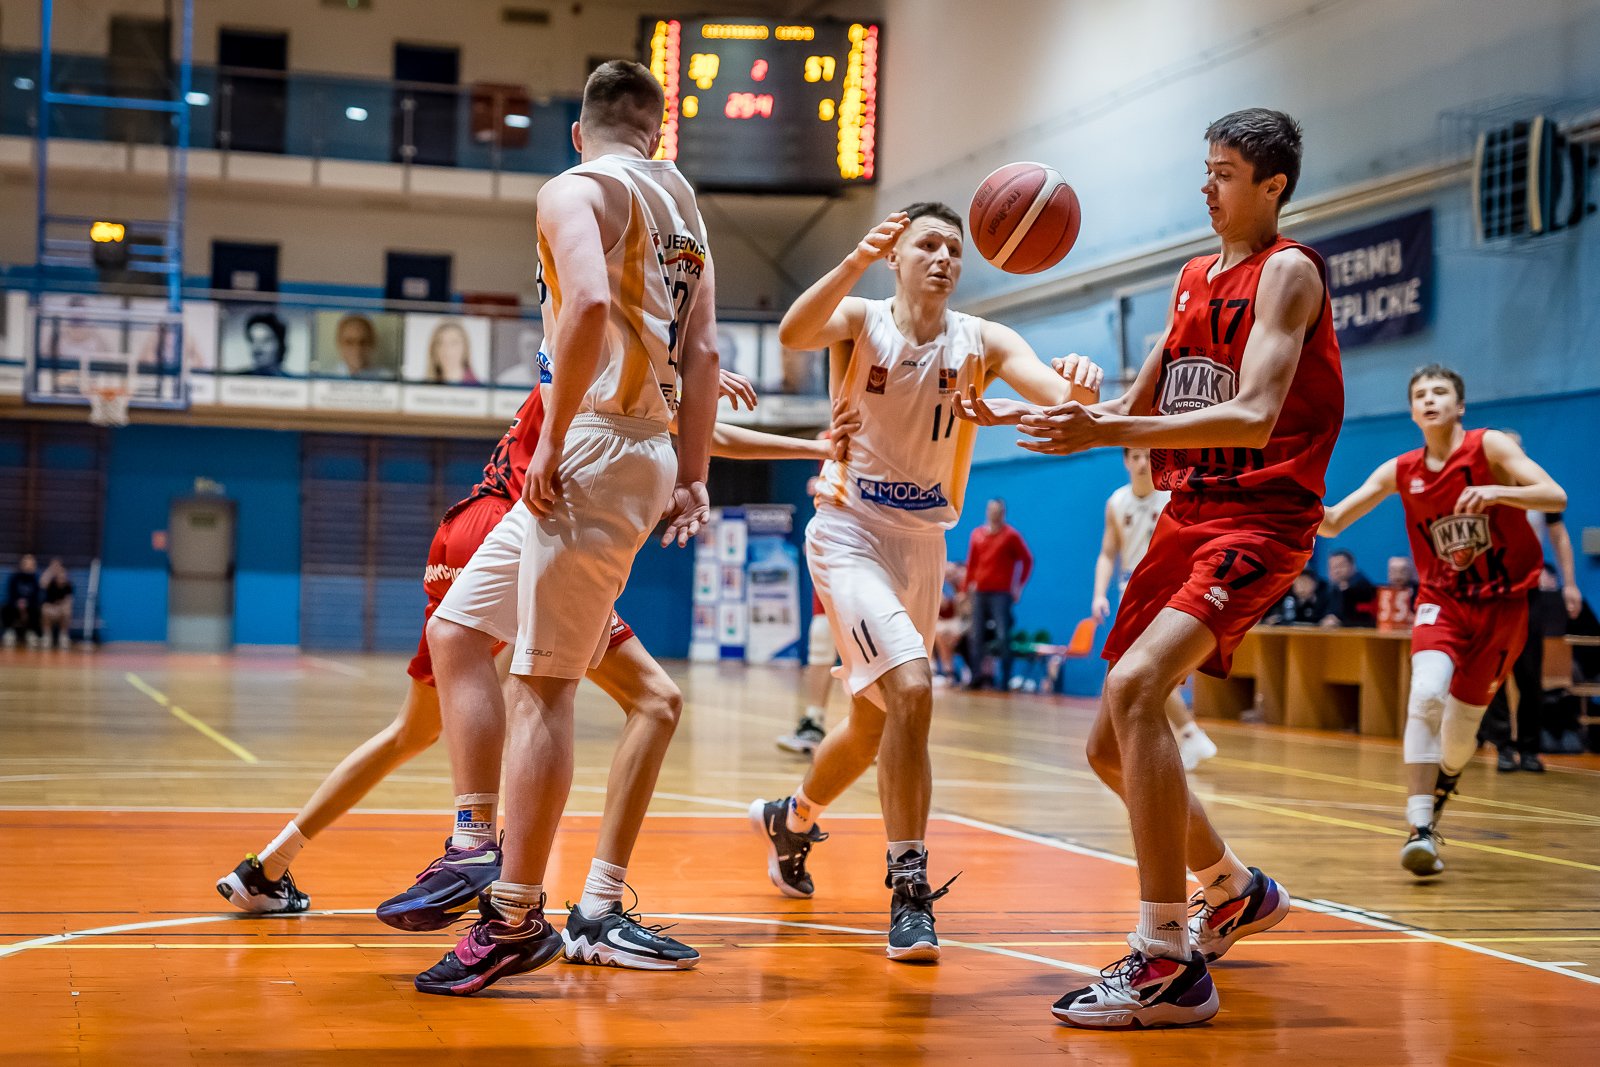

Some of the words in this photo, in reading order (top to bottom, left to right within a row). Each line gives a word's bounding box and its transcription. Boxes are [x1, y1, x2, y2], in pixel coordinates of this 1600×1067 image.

[987, 189, 1022, 236] molten
[1327, 238, 1402, 289] TERMY
[1209, 298, 1250, 345] 17
[1174, 366, 1223, 403] WKK
[1440, 520, 1481, 546] WKK
[1213, 548, 1268, 591] 17
[526, 649, 552, 657] COLO
[852, 618, 879, 664] 11
